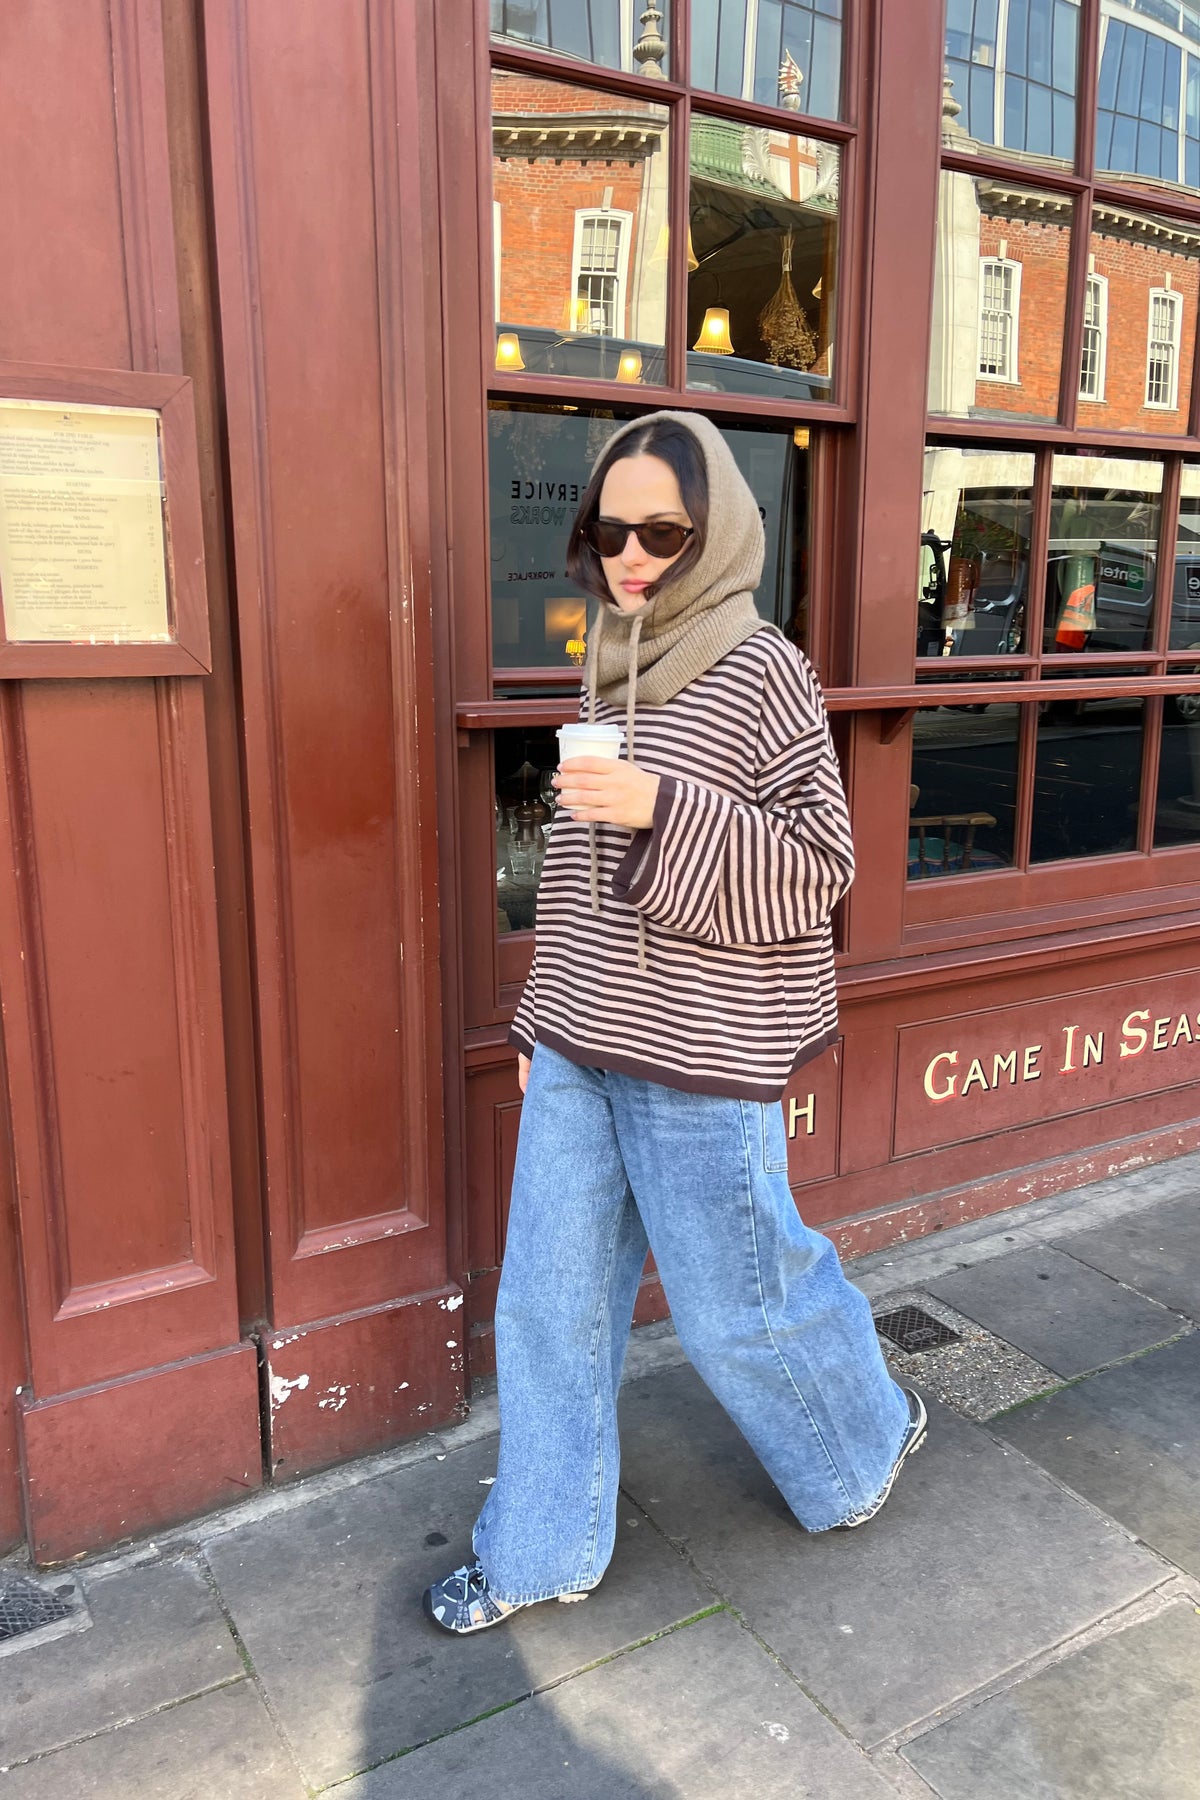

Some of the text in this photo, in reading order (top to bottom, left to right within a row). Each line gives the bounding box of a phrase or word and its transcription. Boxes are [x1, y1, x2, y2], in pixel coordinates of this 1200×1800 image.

[923, 1044, 1042, 1102] GAME
[1059, 1025, 1104, 1073] IN
[788, 1093, 815, 1139] H
